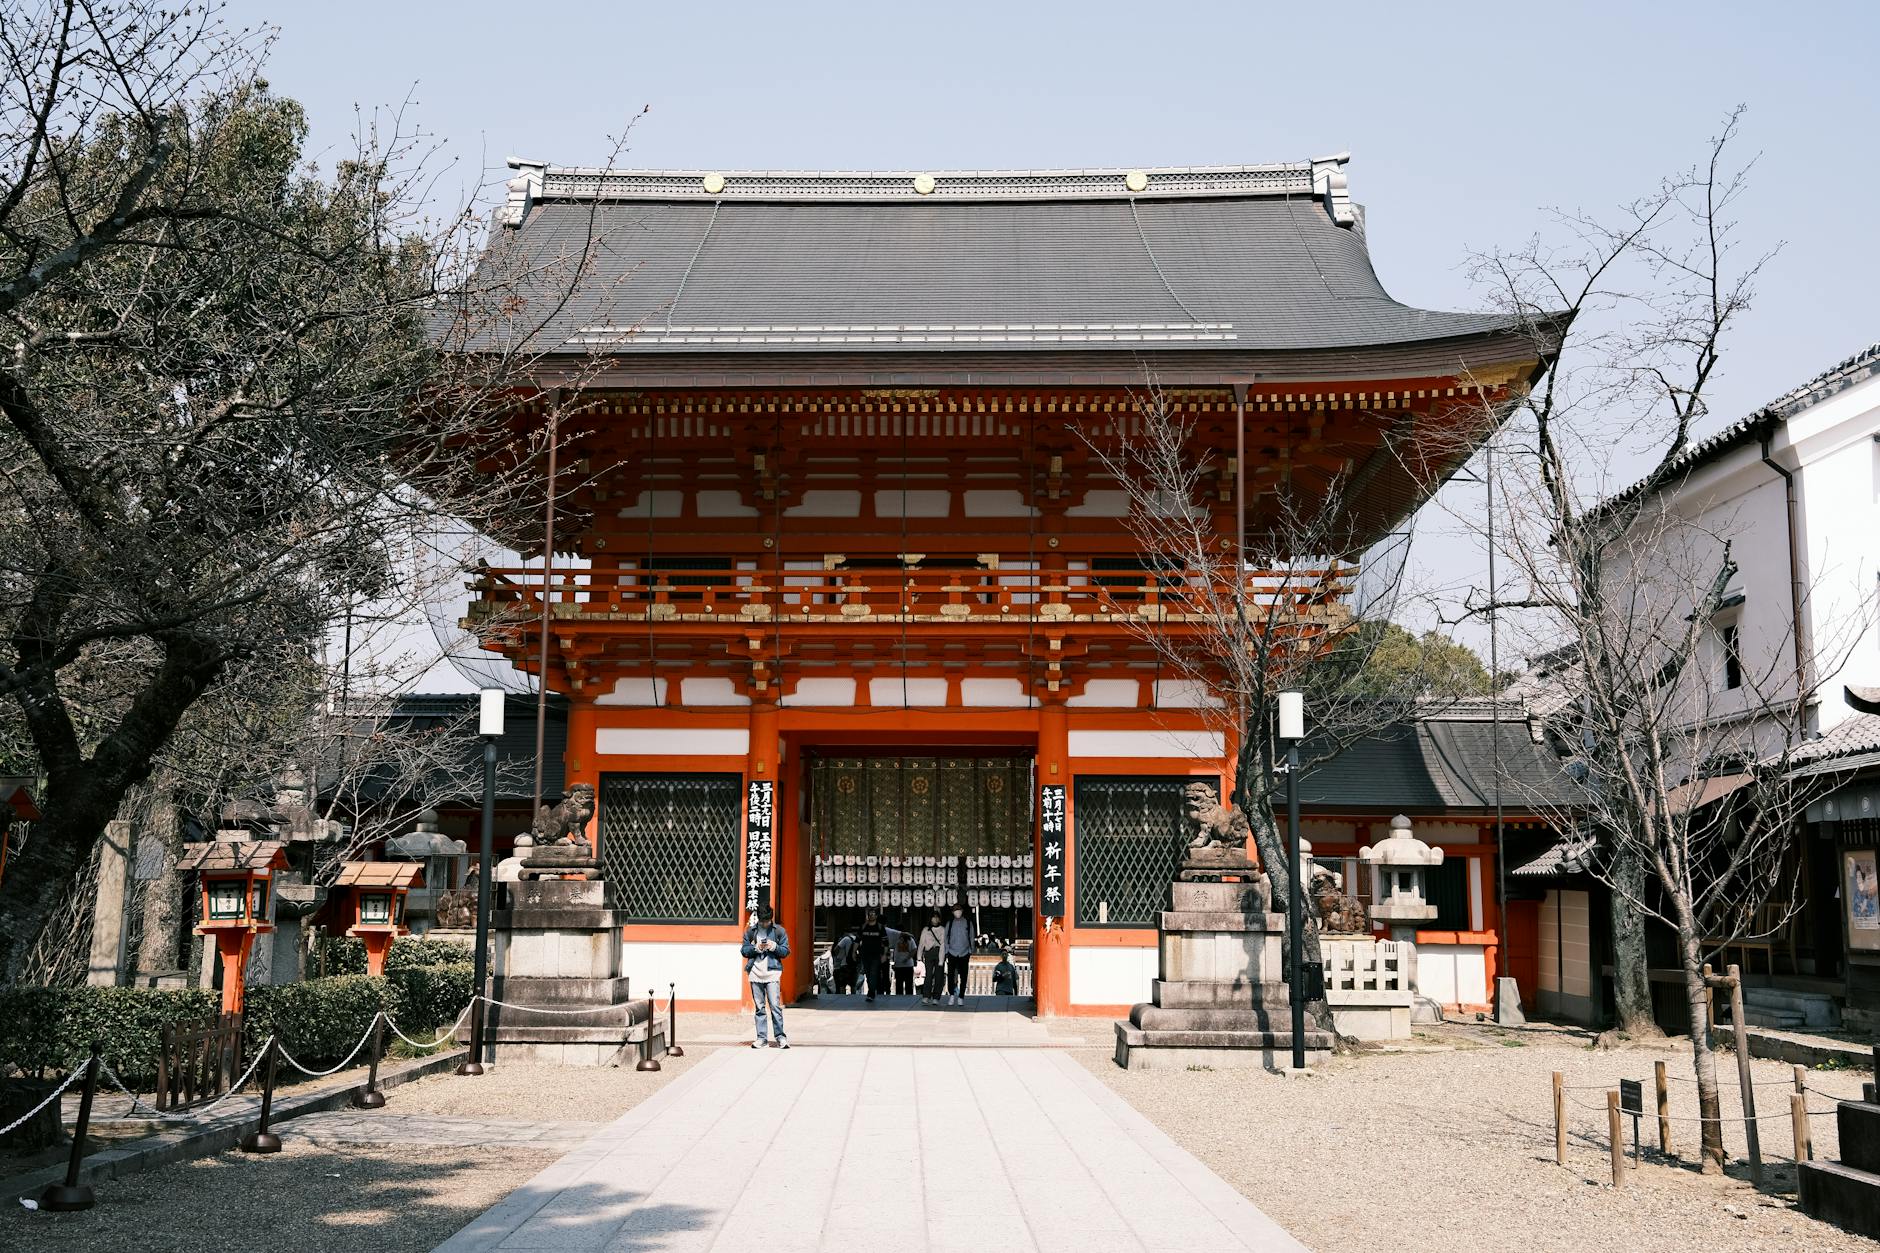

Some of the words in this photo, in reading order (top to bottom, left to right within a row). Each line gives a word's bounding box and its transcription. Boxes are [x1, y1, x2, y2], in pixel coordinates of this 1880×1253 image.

[749, 782, 761, 826] 午後二時
[760, 783, 772, 827] 三月十九日
[1043, 787, 1054, 832] 午前十時
[1053, 789, 1064, 832] 三月十七日
[759, 832, 771, 887] 玉光稲荷社
[1045, 842, 1061, 903] 祈年祭
